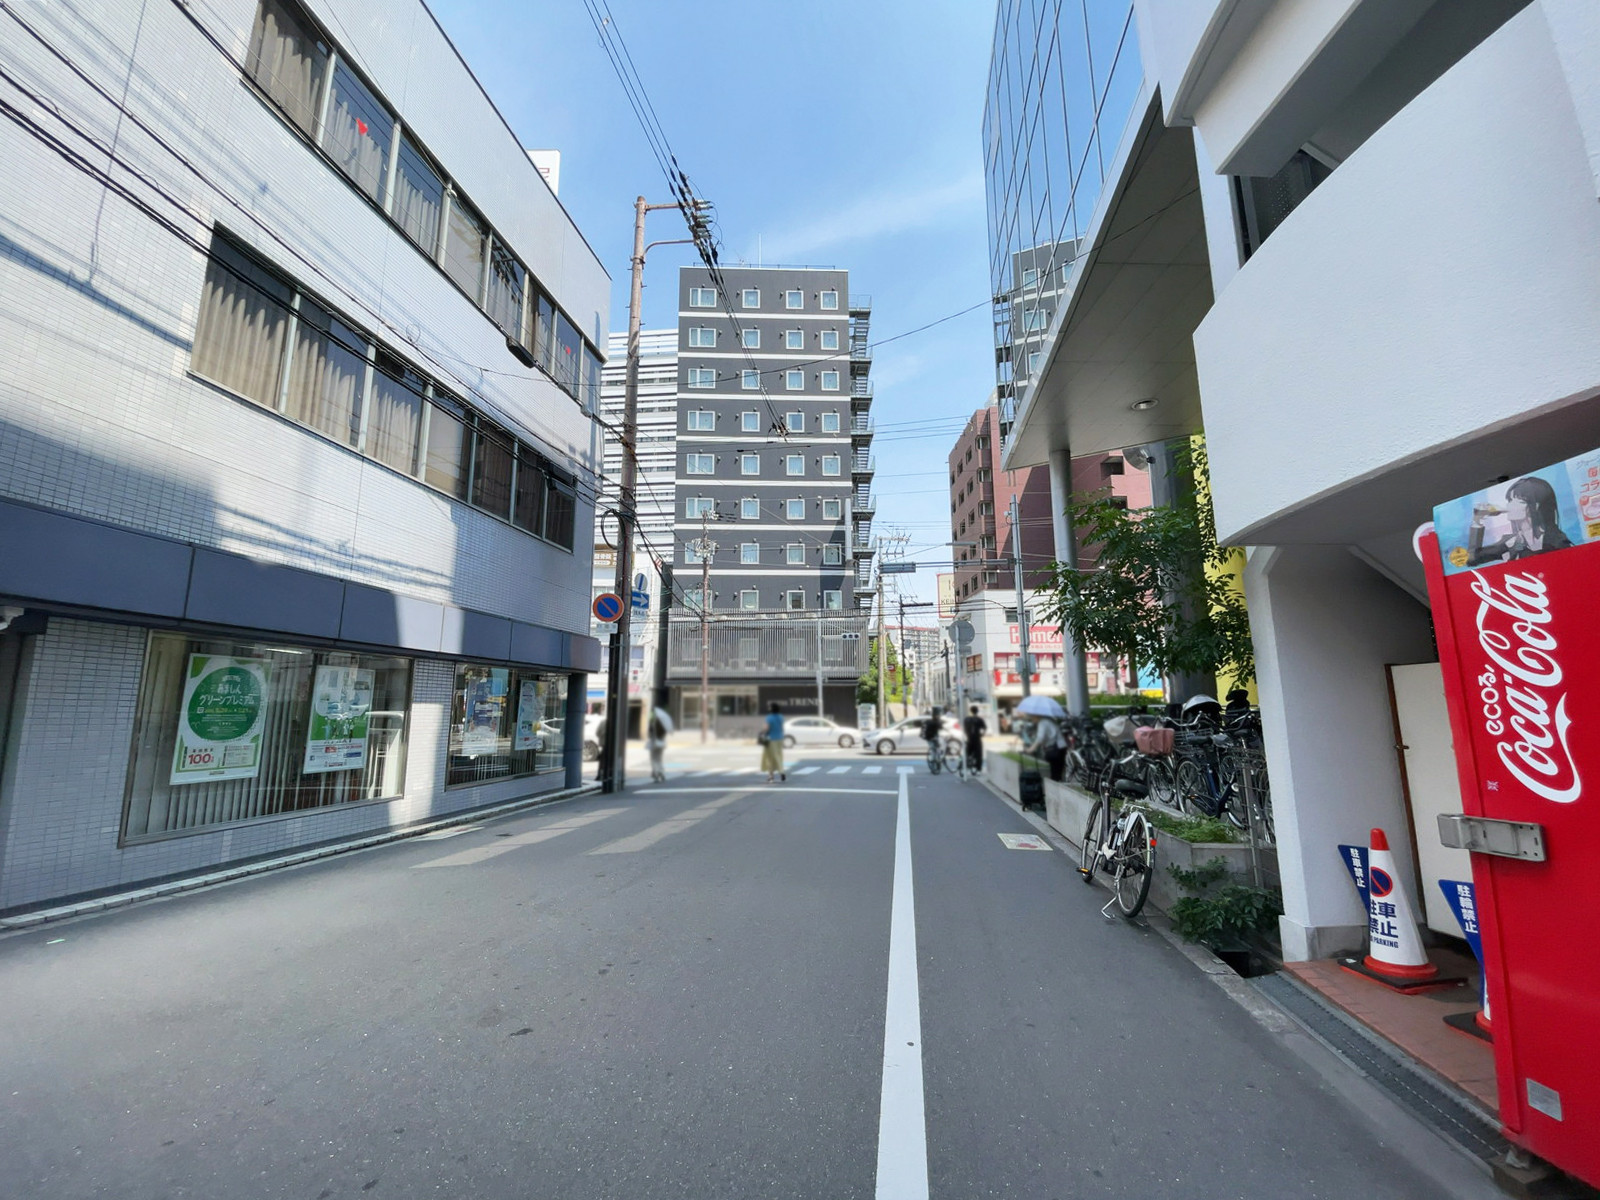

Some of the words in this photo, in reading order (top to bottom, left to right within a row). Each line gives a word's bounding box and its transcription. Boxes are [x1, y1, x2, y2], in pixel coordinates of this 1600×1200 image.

[199, 694, 255, 706] グリーンプレミアム
[1470, 569, 1582, 804] Coca-Cola
[1350, 848, 1366, 888] 駐車禁止
[1457, 884, 1478, 933] 駐輪禁止
[1373, 936, 1399, 948] PARKING
